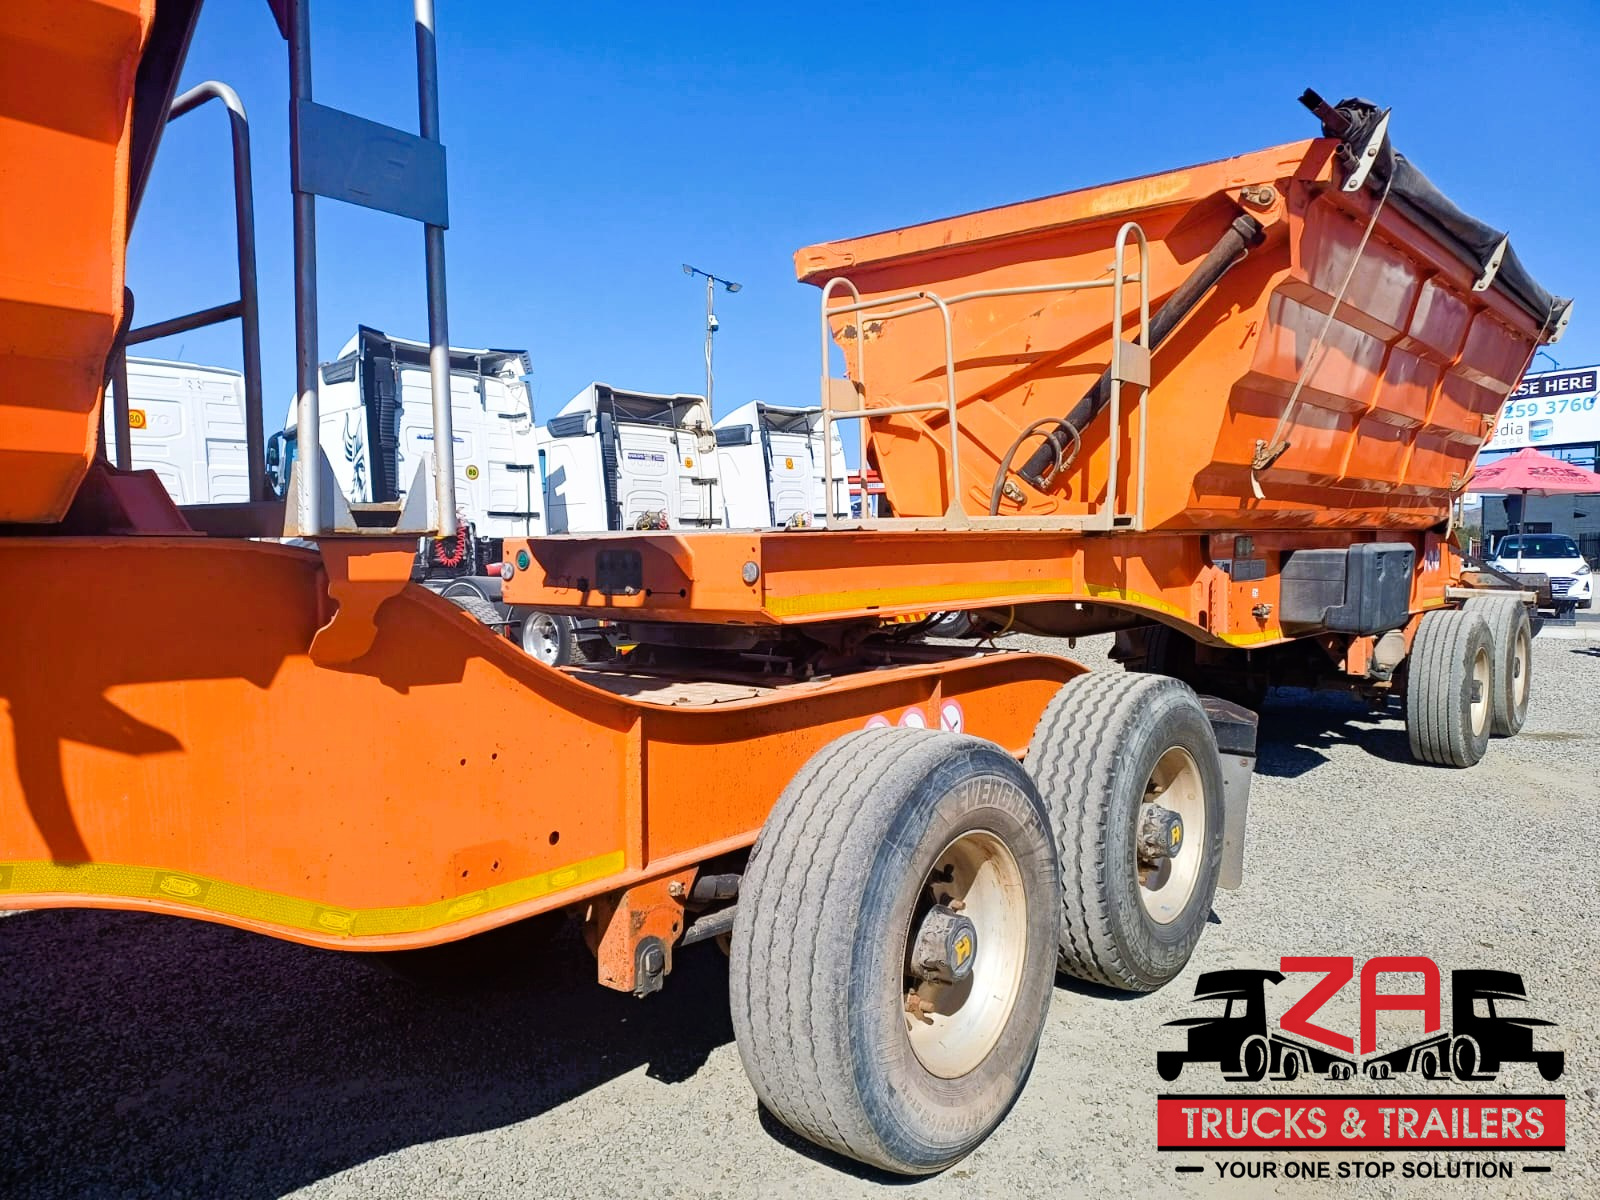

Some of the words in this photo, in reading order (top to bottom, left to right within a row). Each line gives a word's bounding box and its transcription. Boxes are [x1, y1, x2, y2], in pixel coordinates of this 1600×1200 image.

[1545, 375, 1593, 393] HERE
[1504, 403, 1538, 419] 259
[1545, 396, 1595, 418] 3760
